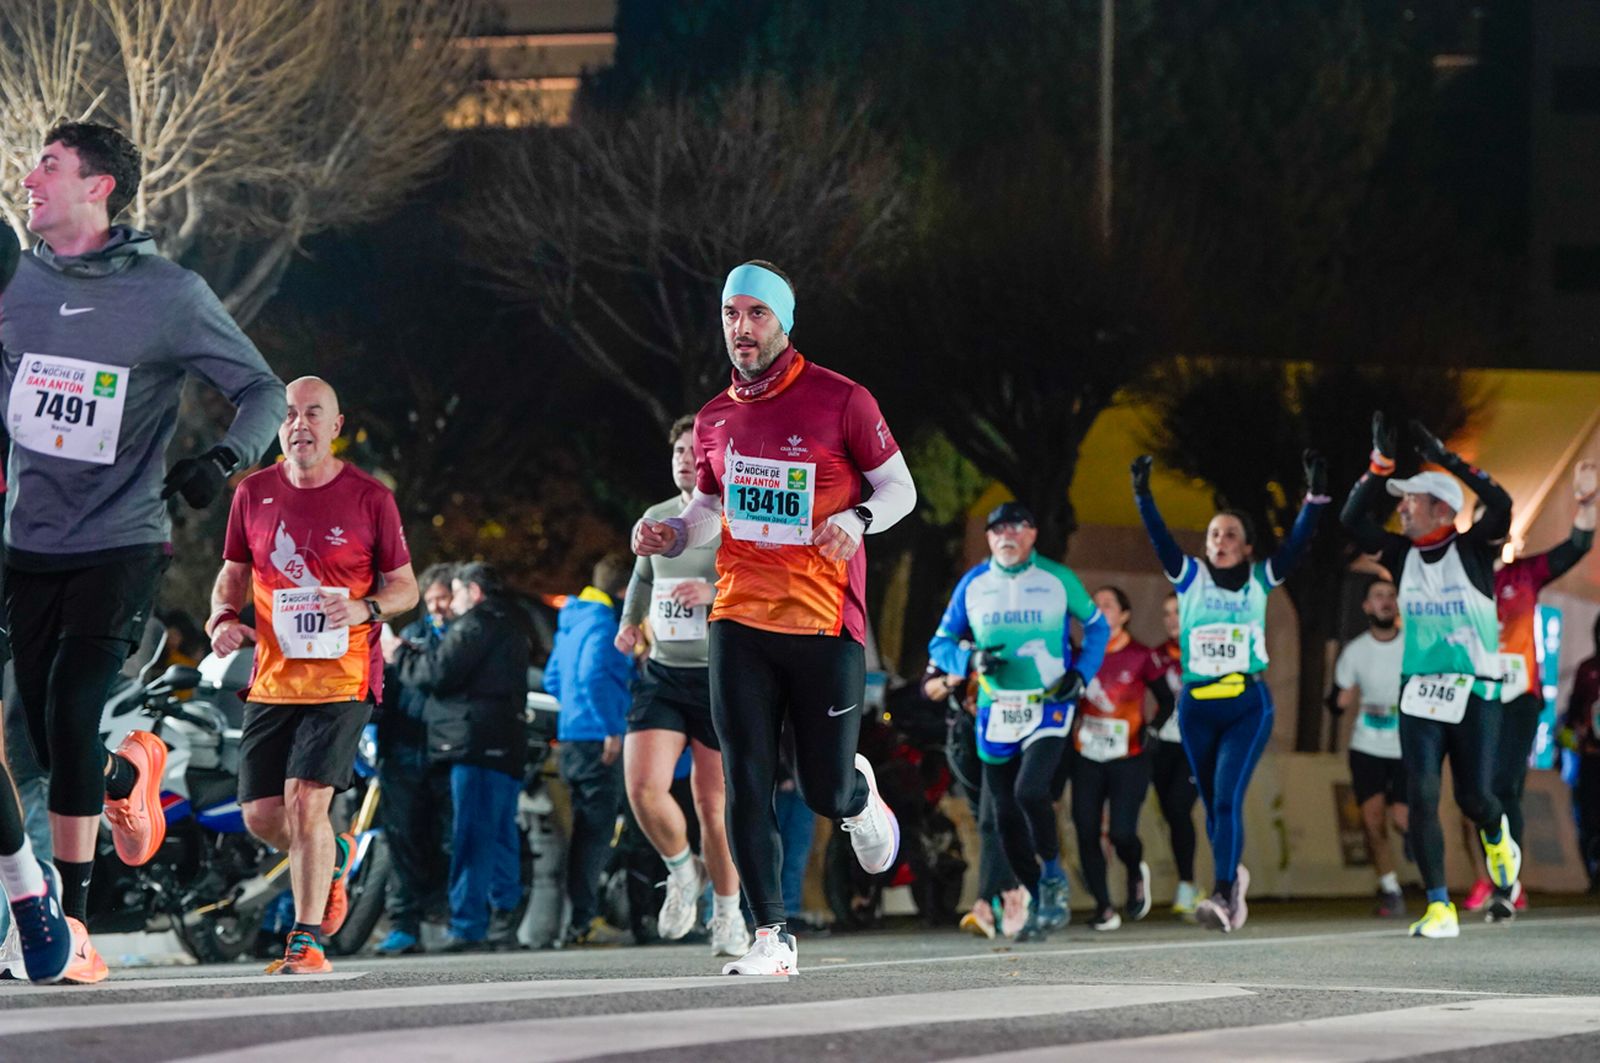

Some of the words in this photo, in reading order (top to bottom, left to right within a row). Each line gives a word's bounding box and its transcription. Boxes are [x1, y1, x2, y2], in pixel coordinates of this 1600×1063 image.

[26, 376, 46, 387] SAN
[42, 367, 70, 379] NOCHE
[73, 372, 85, 382] DE
[34, 390, 98, 427] 7491
[744, 466, 769, 477] NOCHE
[770, 468, 780, 478] DE
[734, 475, 751, 485] SAN
[737, 486, 800, 517] 13416
[284, 560, 304, 580] 43
[294, 612, 326, 633] 107
[1003, 610, 1042, 624] GILETE
[1202, 643, 1236, 658] 1549
[1418, 684, 1455, 702] 5746
